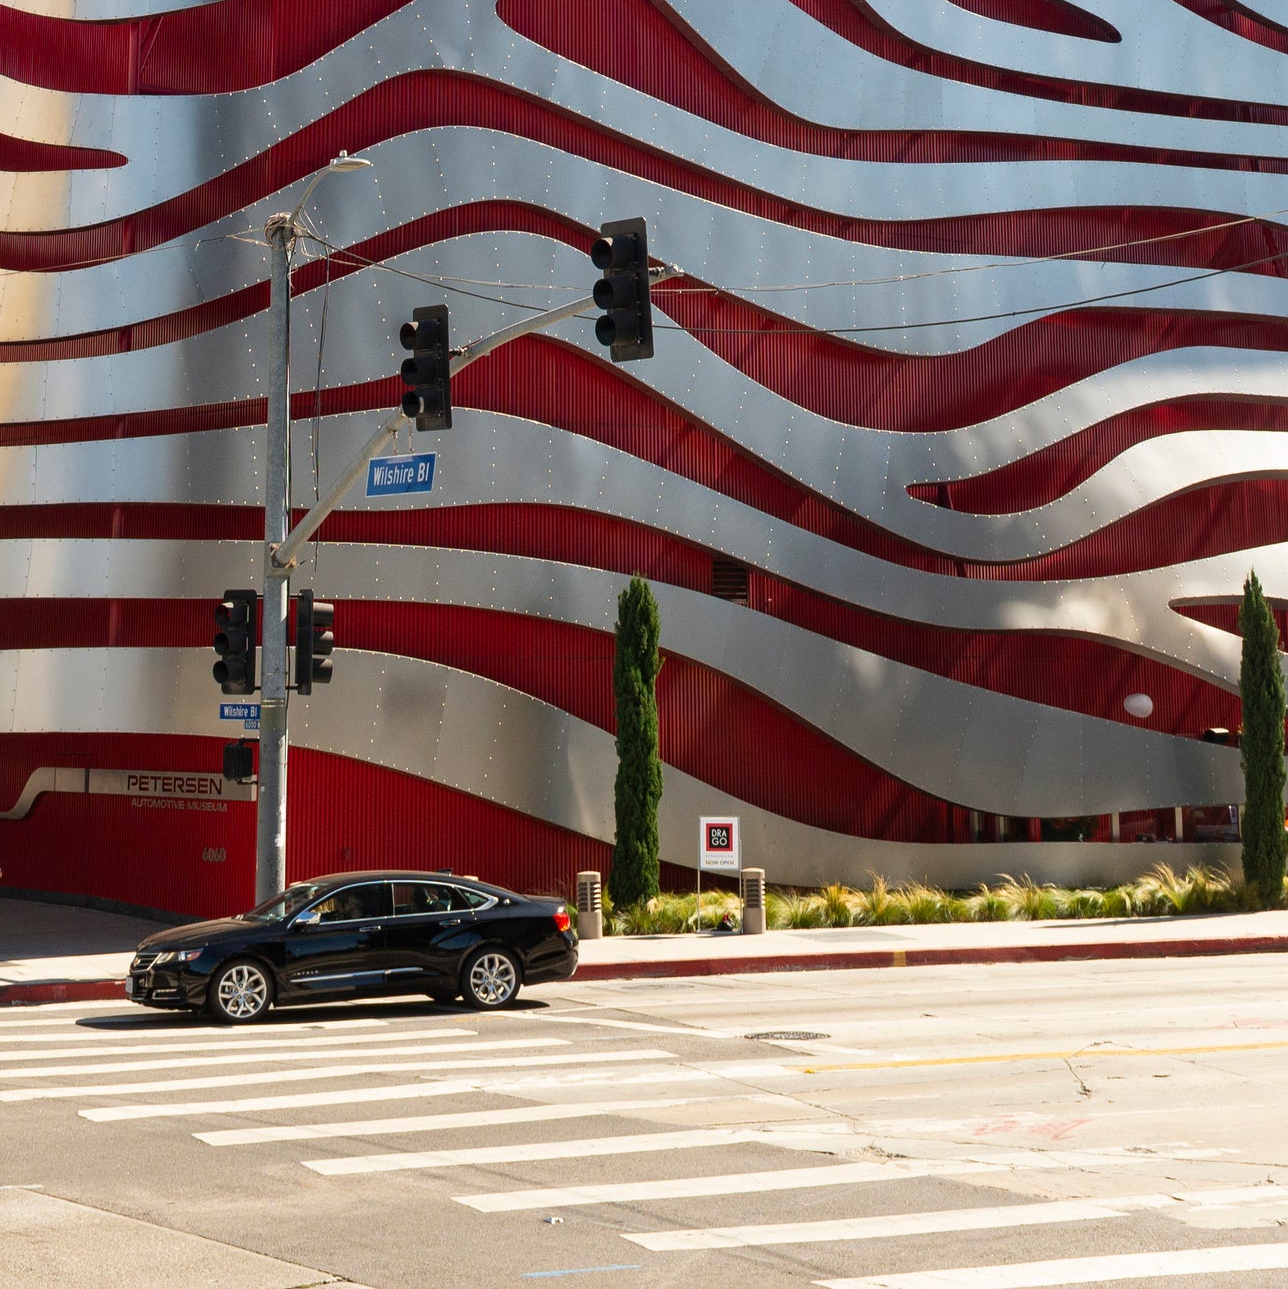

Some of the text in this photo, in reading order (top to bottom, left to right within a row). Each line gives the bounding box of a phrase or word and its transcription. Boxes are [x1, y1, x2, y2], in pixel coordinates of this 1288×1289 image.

[373, 462, 430, 486] Wilshire Bl
[223, 705, 258, 718] Wilshire Bl
[127, 774, 222, 795] PETERSEN
[131, 798, 228, 812] AUTOMOTIVE MUSEUM
[711, 828, 727, 838] DRA
[711, 837, 728, 846] GO
[202, 847, 226, 862] 6060
